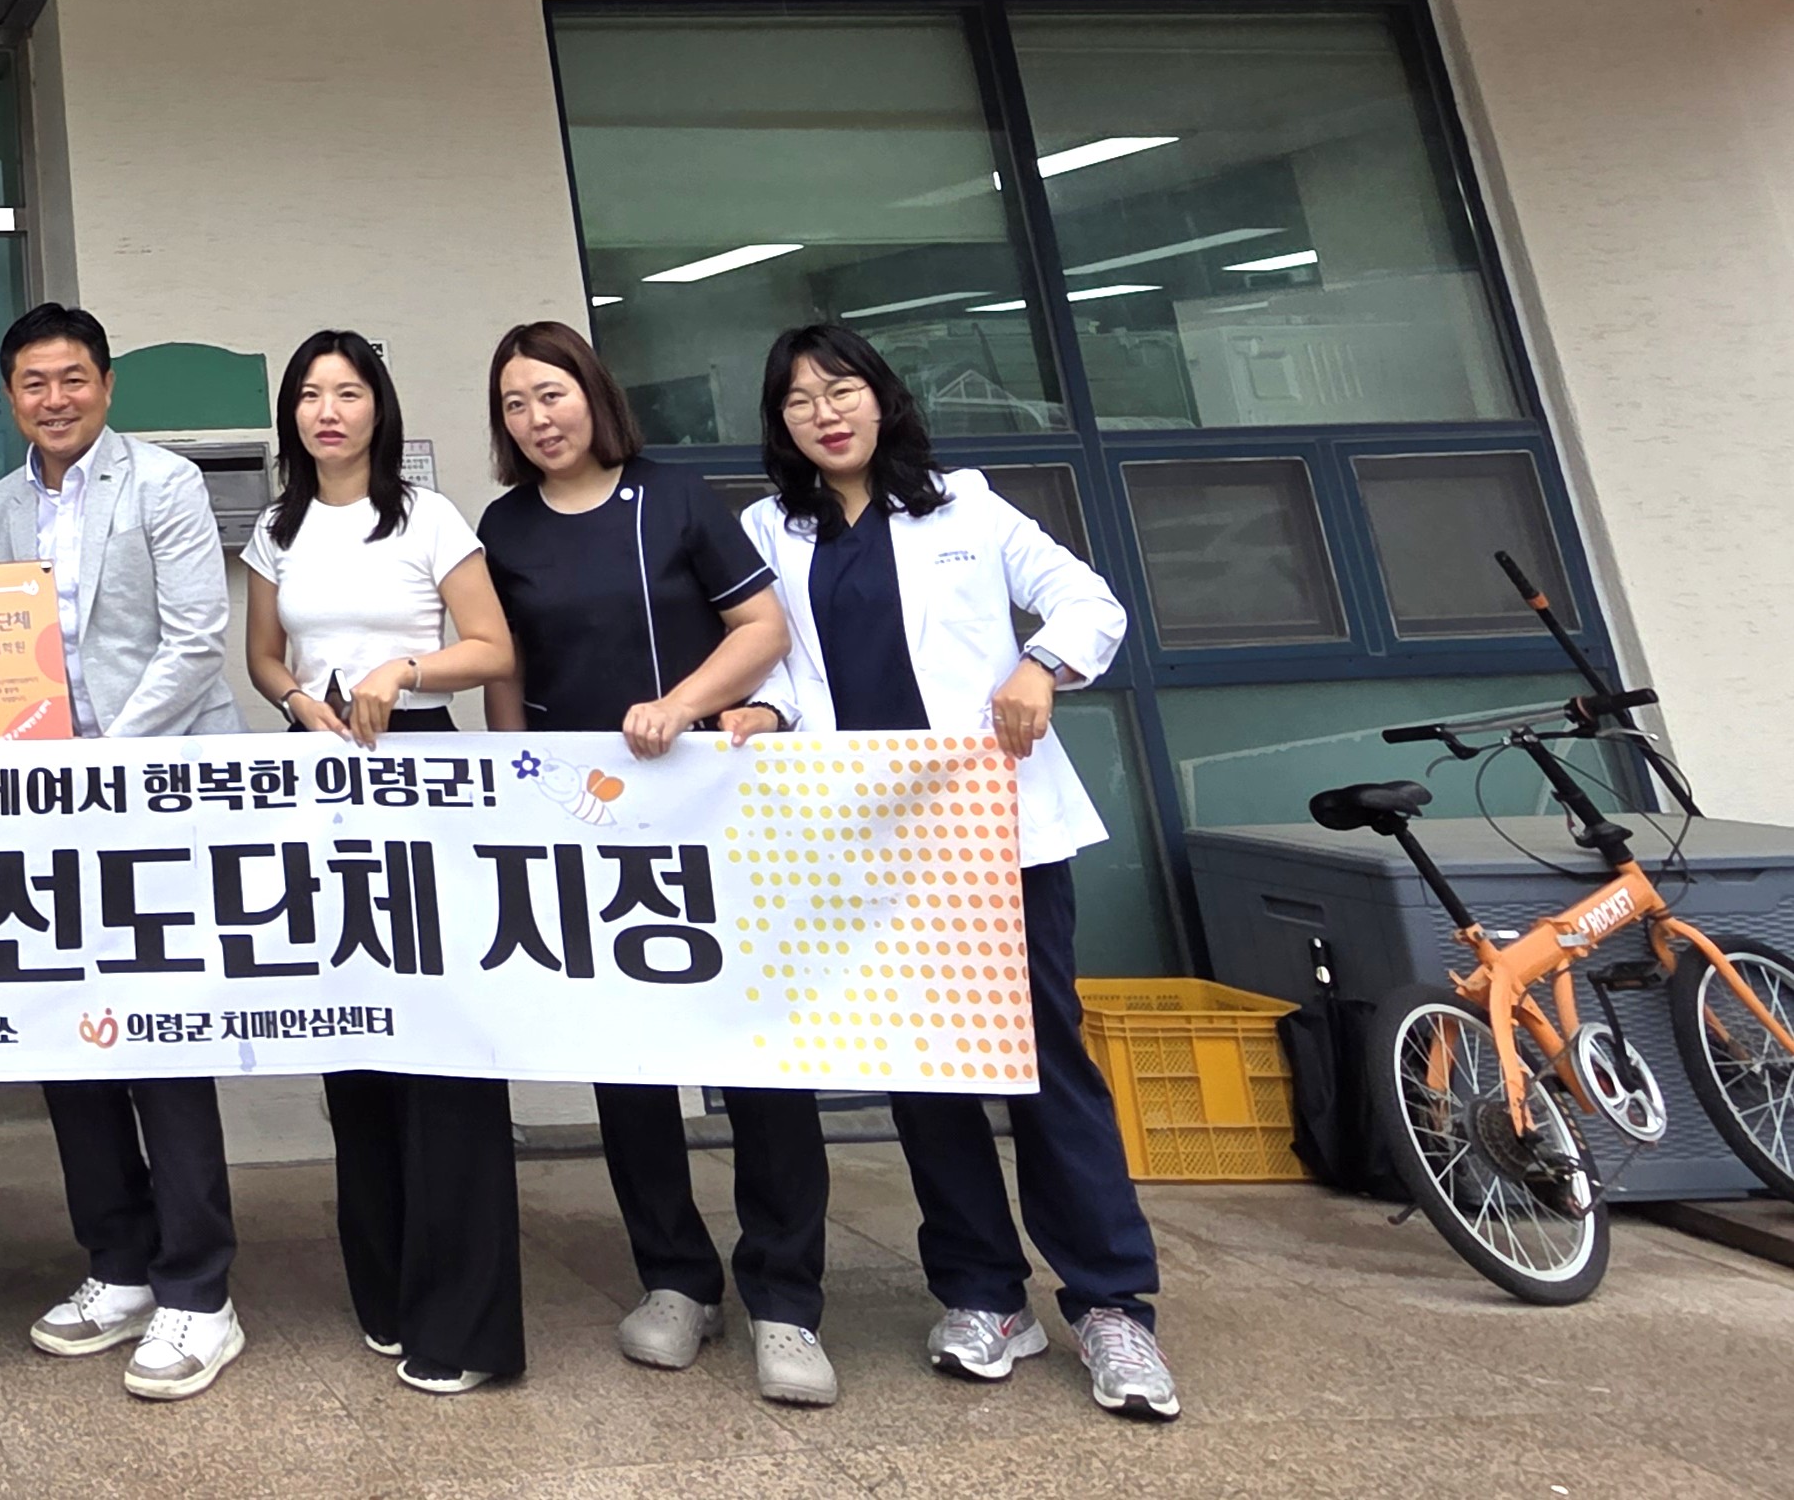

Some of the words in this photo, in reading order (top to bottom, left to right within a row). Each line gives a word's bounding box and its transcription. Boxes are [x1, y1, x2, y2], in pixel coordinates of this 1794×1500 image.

[142, 759, 299, 813] 행복한
[315, 756, 497, 808] 의령군!
[472, 843, 724, 985] 지정
[127, 1012, 213, 1043] 의령군
[220, 1006, 394, 1041] 치매안심센터
